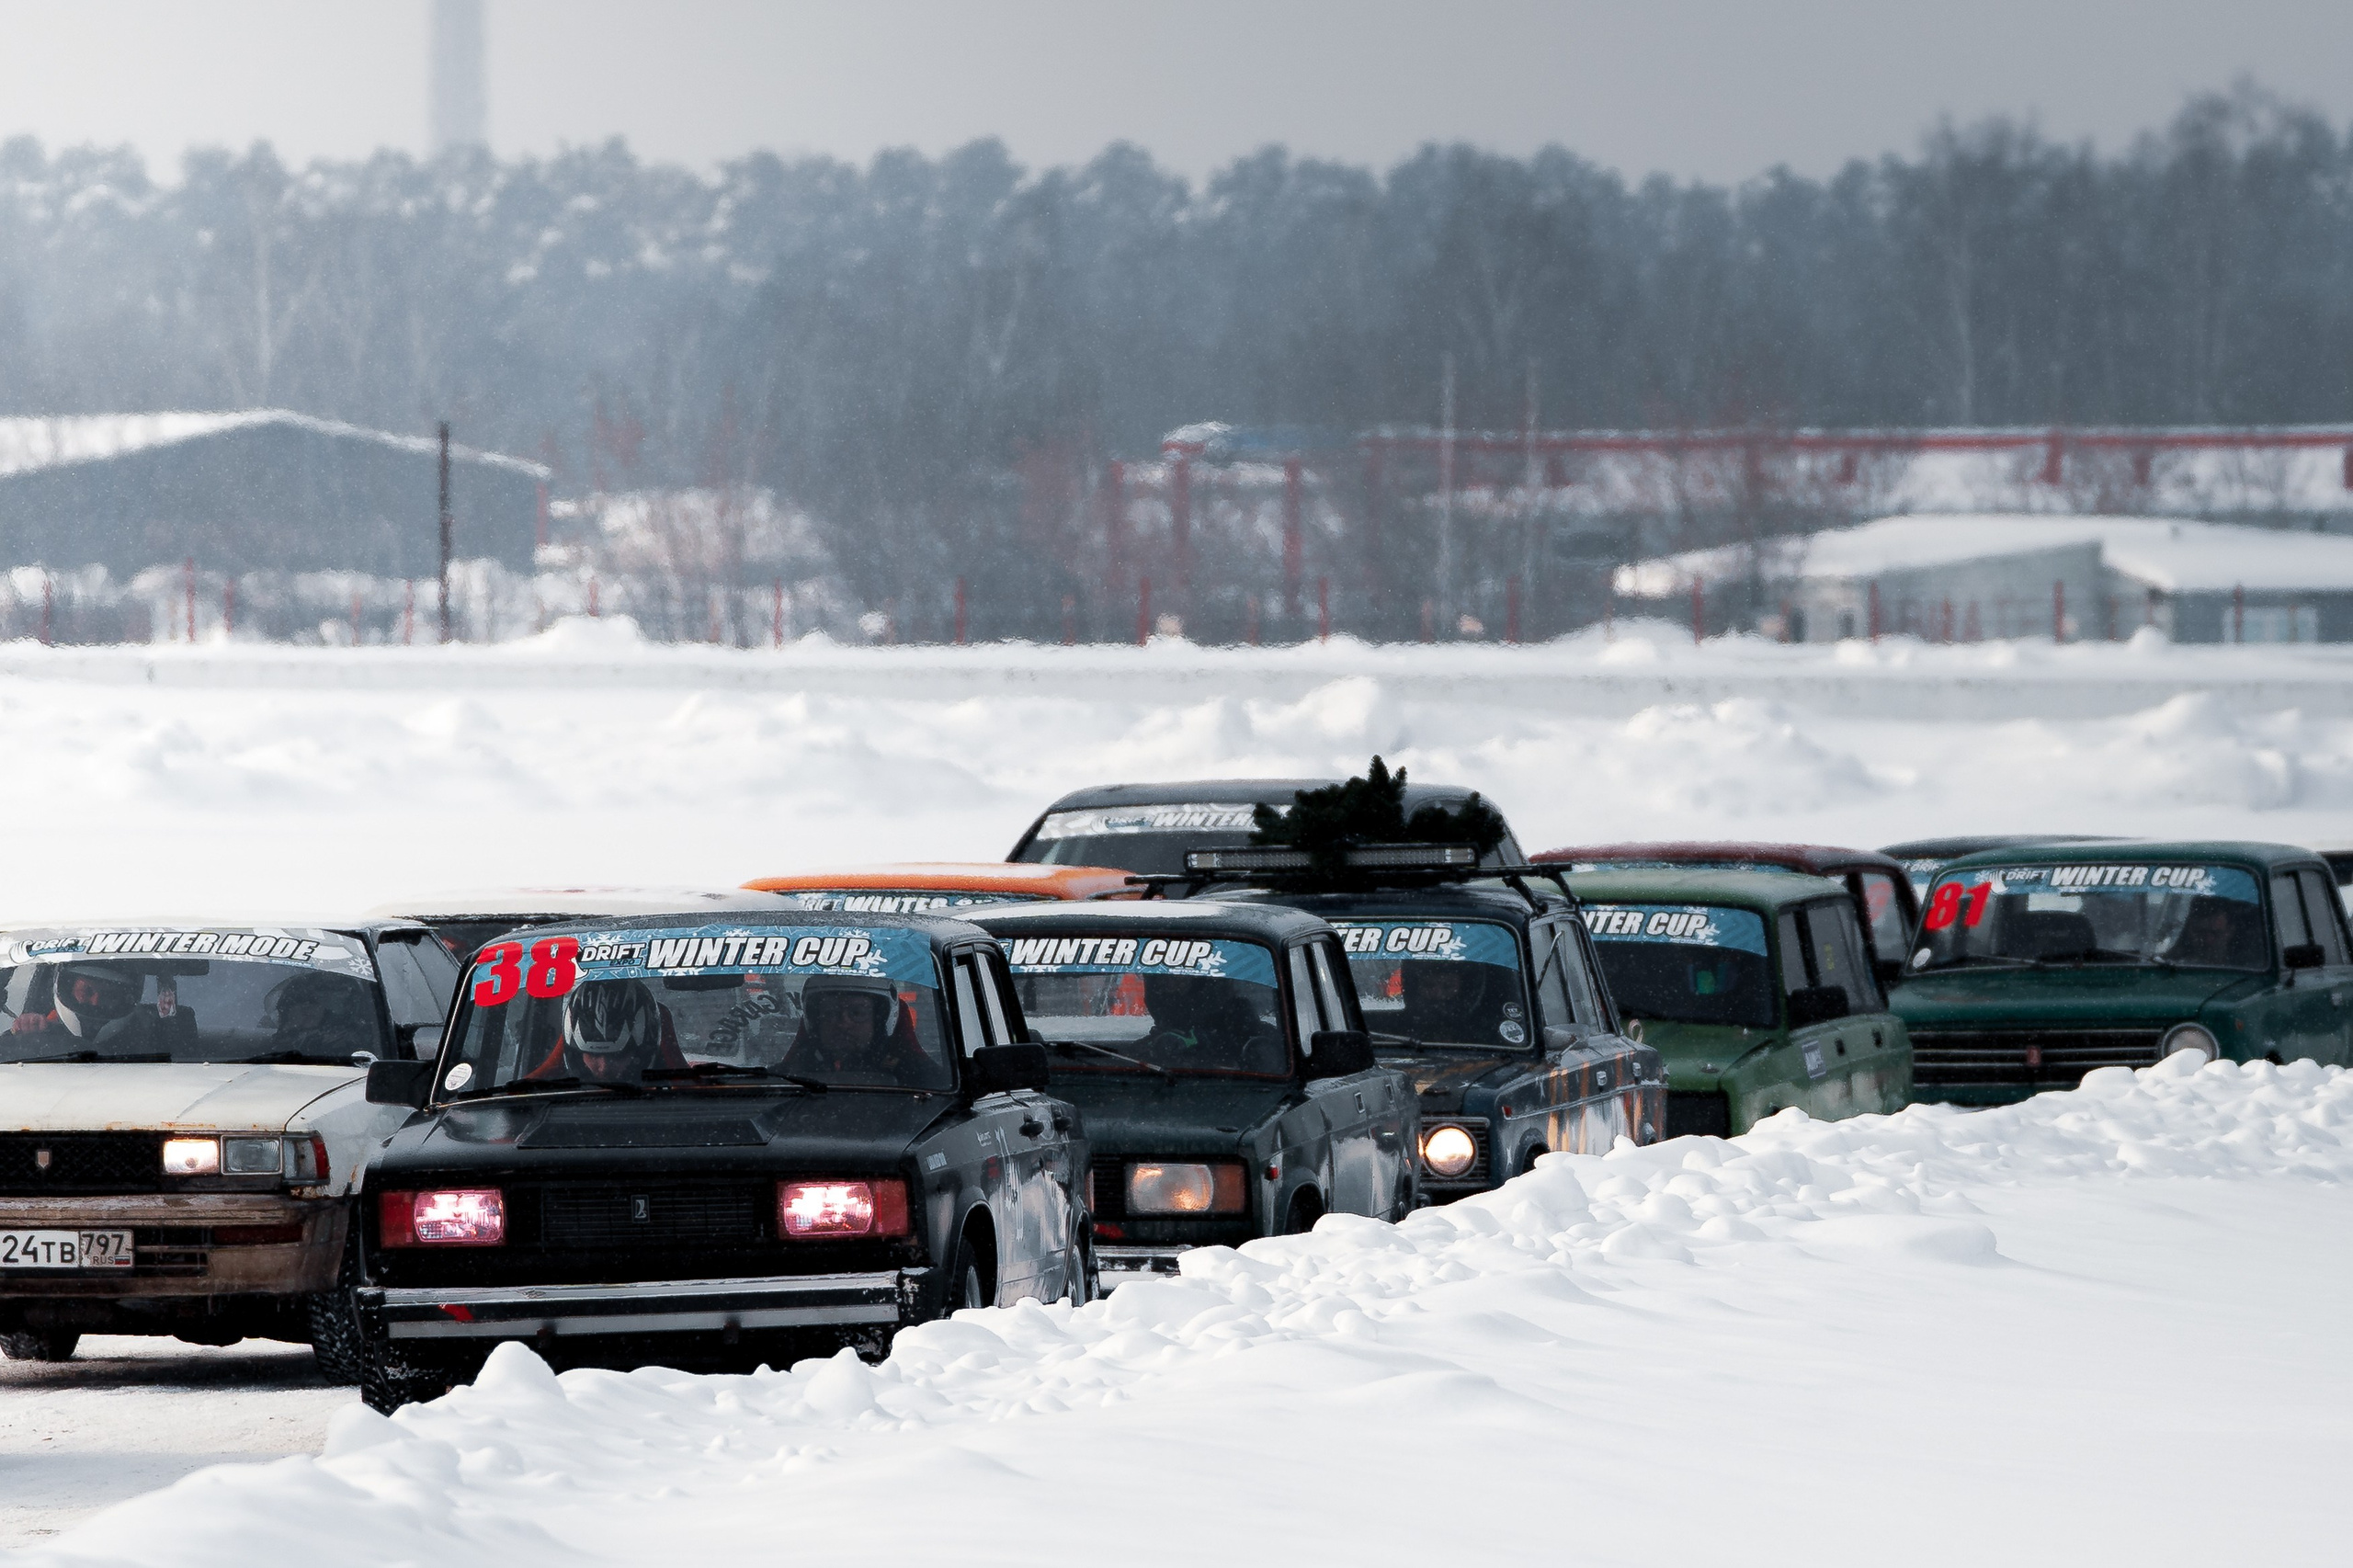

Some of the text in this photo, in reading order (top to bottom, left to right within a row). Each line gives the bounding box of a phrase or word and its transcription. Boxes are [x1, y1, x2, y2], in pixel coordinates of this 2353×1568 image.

[2006, 866, 2206, 888] DRIFT WINTER CUP
[1925, 881, 1993, 930] 81
[1646, 912, 1708, 937] CUP
[32, 933, 320, 961] DRIFT WINTER MODE
[581, 937, 871, 968] DRIFT WINTER CUP
[1010, 937, 1213, 967] WINTER CUP
[1385, 926, 1453, 953] CUP
[474, 936, 579, 1006] 38
[81, 1233, 125, 1256] 797
[93, 1256, 115, 1265] RUS
